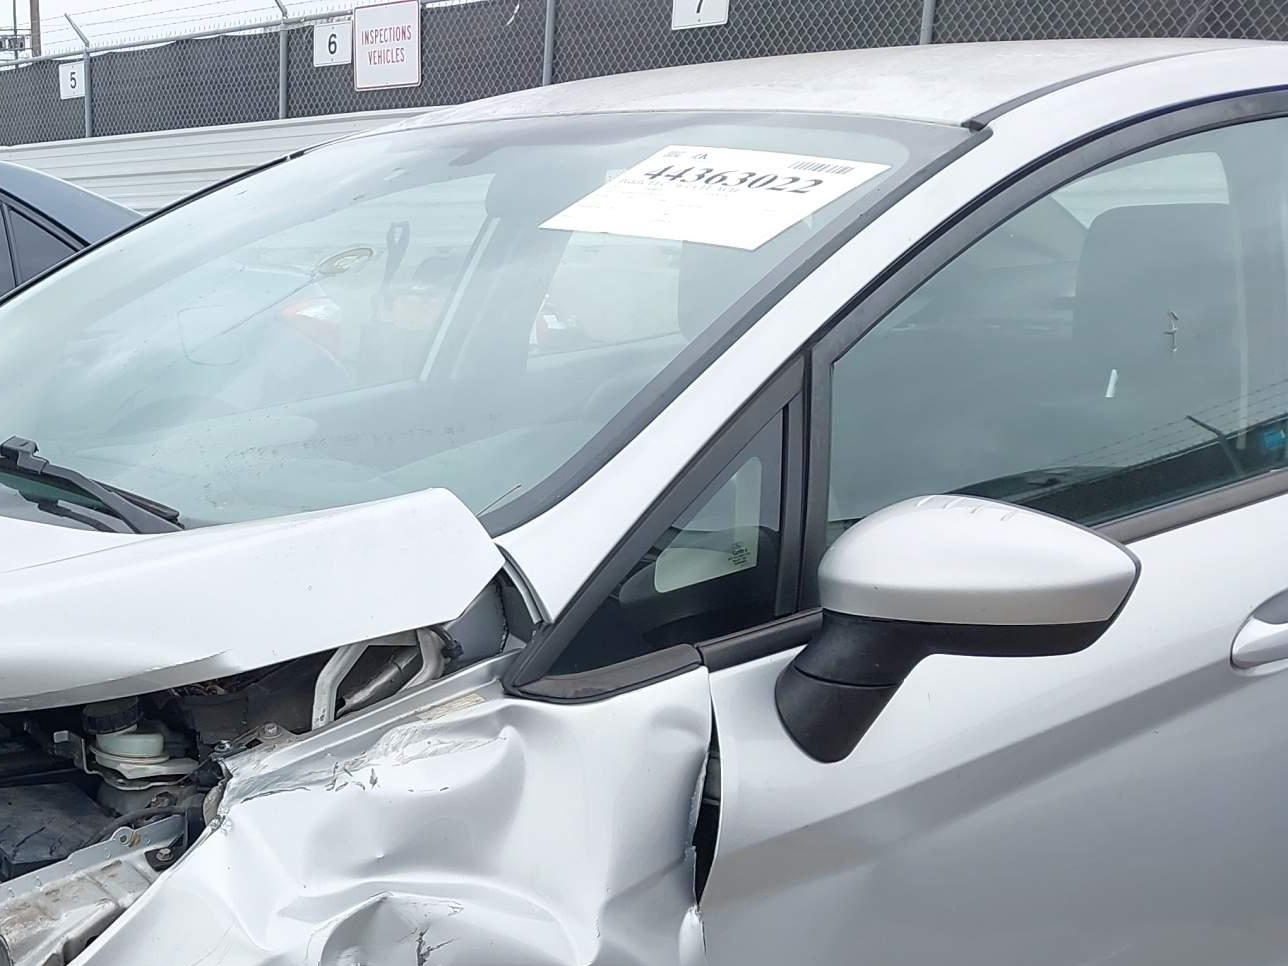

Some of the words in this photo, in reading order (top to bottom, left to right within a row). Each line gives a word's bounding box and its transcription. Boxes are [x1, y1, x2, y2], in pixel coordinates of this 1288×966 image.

[327, 33, 337, 55] 6
[361, 25, 412, 46] INSPECTIONS
[368, 47, 405, 65] VEHICLES
[70, 71, 77, 89] 5
[643, 164, 824, 194] 44363022
